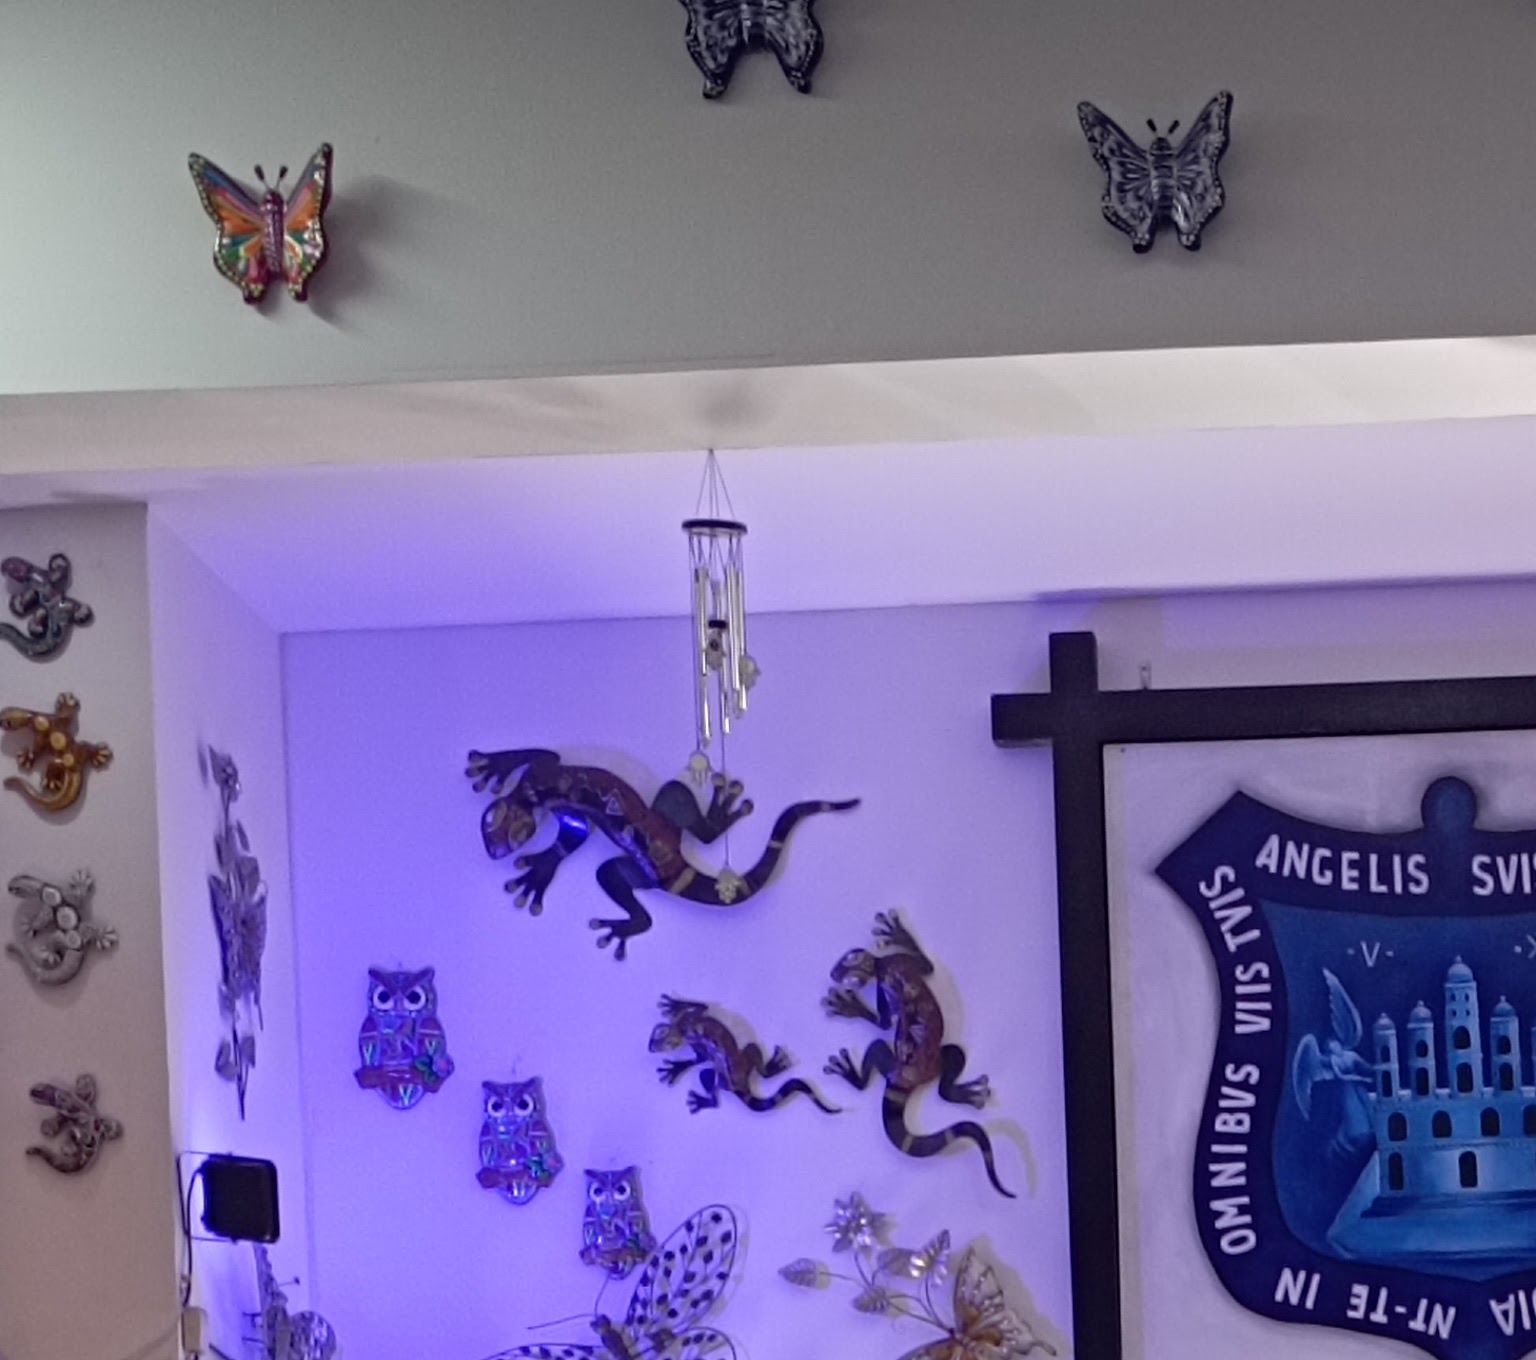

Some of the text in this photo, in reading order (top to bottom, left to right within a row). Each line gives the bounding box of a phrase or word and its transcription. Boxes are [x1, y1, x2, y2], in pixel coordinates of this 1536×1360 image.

[1255, 834, 1430, 894] ANGELIS
[1198, 864, 1262, 953] TVIS
[1234, 960, 1273, 1035] VIIS
[1208, 1062, 1261, 1256] OMNIBVS
[1275, 1268, 1320, 1309] IN
